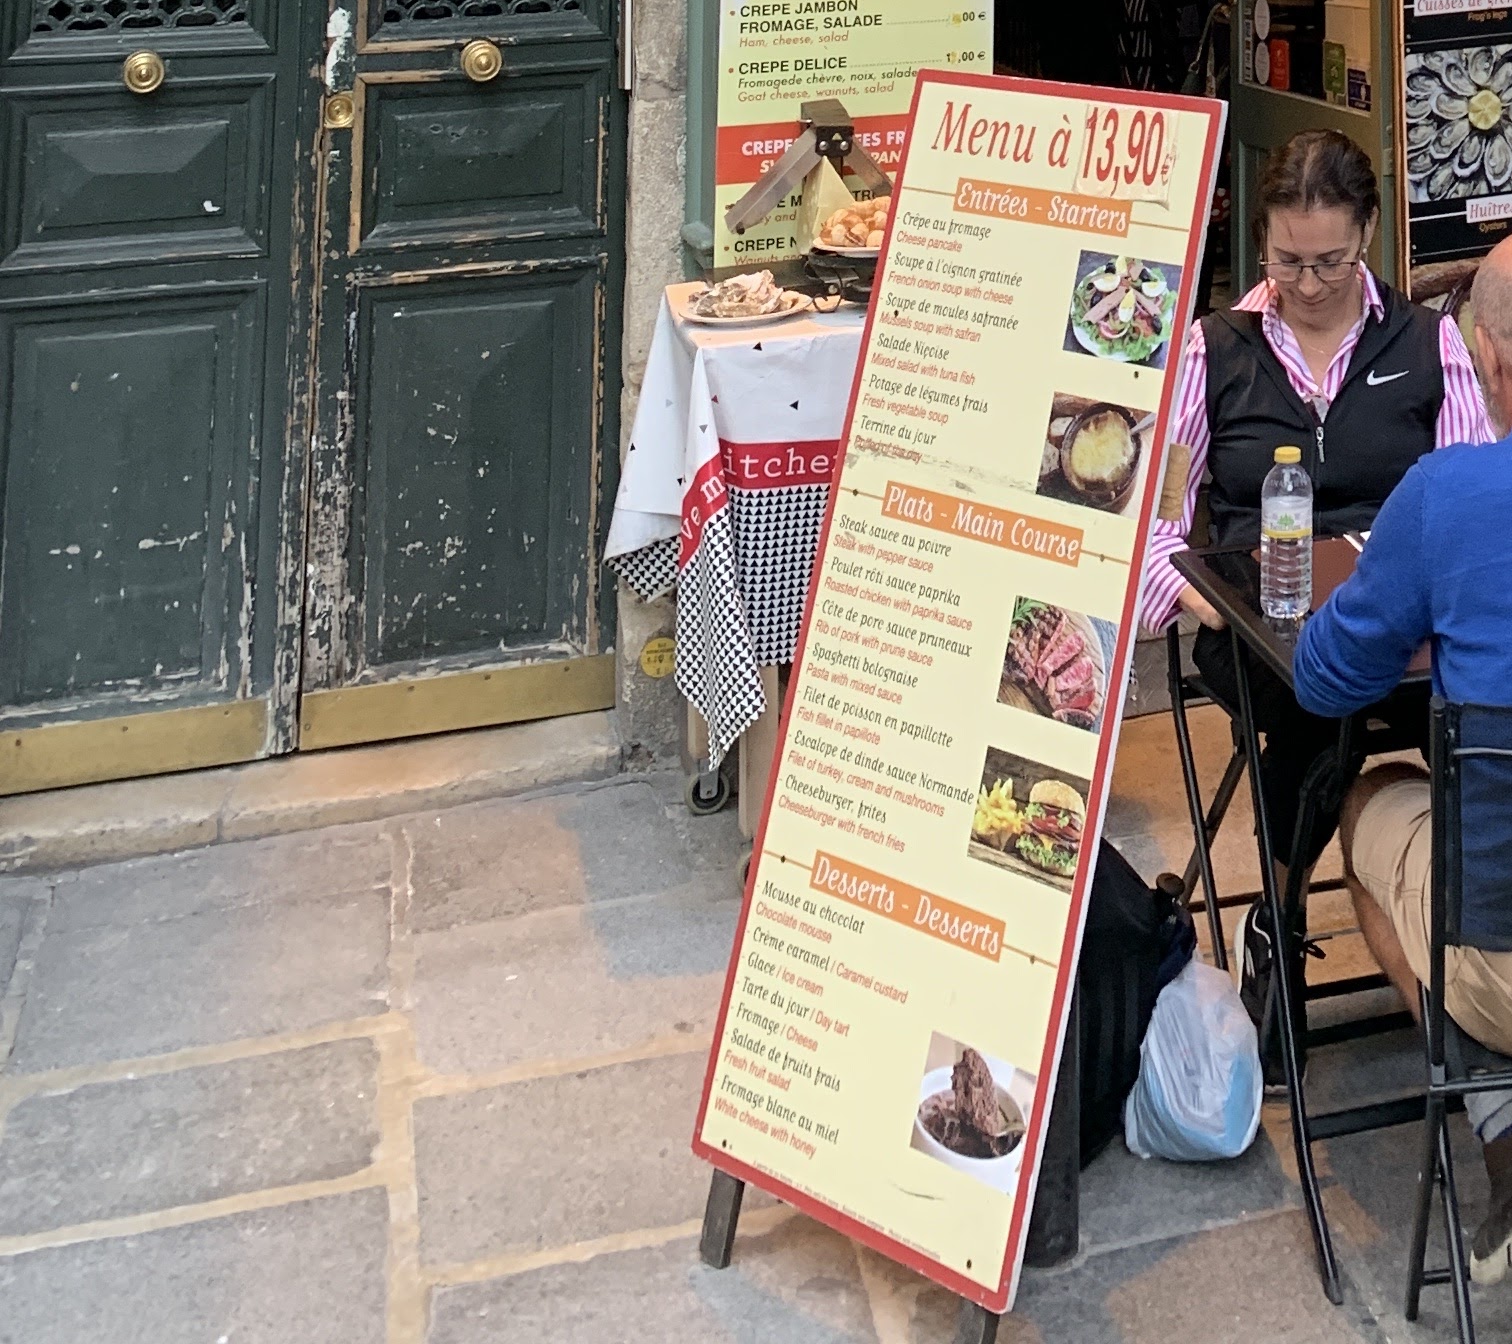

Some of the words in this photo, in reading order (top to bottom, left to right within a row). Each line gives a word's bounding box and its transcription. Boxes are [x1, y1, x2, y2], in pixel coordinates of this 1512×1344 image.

[739, 2, 792, 19] CREPE
[739, 17, 819, 35] FROMAGE,
[822, 13, 884, 30] SALADE
[737, 59, 790, 76] CREPE
[793, 55, 848, 72] DELICE
[930, 100, 1037, 164] Menu
[1047, 113, 1073, 169] à
[902, 210, 932, 231] Crêpe
[931, 218, 947, 232] au
[946, 218, 992, 242] fromage
[956, 181, 1029, 218] Entrées
[1046, 194, 1127, 233] Starters
[734, 238, 780, 253] CREPE
[893, 250, 926, 272] Soupe
[977, 269, 1024, 288] gratinée
[885, 291, 917, 313] Soupe
[917, 298, 932, 314] de
[932, 303, 970, 322] moules
[970, 310, 1020, 331] safranée
[876, 332, 912, 353] Salade
[912, 339, 951, 361] Niçoise
[867, 373, 903, 397] Potage
[903, 381, 918, 398] de
[918, 384, 961, 408] légumes
[961, 394, 989, 414] frais
[860, 413, 897, 437] Terrine
[896, 424, 913, 441] du
[911, 430, 938, 446] jour
[838, 513, 869, 535] Steak
[867, 524, 900, 544] sauce
[900, 533, 916, 549] au
[916, 538, 953, 558] poivre
[884, 485, 934, 524] Plats
[950, 502, 1005, 542] Main
[1010, 517, 1080, 561] Course
[830, 555, 864, 579] Poulet
[864, 567, 884, 585] rôti
[884, 574, 918, 595] sauce
[916, 584, 962, 608] paprika
[821, 598, 845, 619] Côte
[844, 606, 860, 624] de
[858, 613, 885, 631] porc
[885, 621, 918, 641] sauce
[917, 630, 974, 658] pruneaux
[811, 641, 861, 671] Spaghetti
[861, 656, 919, 689] bolognaise
[802, 684, 827, 707] Filet
[826, 693, 842, 712] de
[840, 701, 883, 726] poisson
[883, 715, 899, 731] en
[793, 728, 839, 759] Escalope
[838, 745, 854, 763] de
[853, 750, 885, 774] dinde
[885, 764, 918, 786] sauce
[918, 771, 975, 806] Normande
[856, 799, 887, 825] frites
[761, 879, 802, 909] Mousse
[801, 899, 818, 916] au
[818, 904, 866, 935] chocolat
[812, 855, 896, 914] Desserts
[912, 894, 1000, 956] Desserts
[747, 950, 777, 977] Glace
[752, 925, 786, 953] Crème
[785, 943, 831, 972] caramel
[735, 1001, 781, 1037] Fromage
[741, 975, 770, 1001] Tarte
[769, 989, 786, 1009] du
[784, 999, 811, 1019] jour
[730, 1027, 767, 1057] Salade
[767, 1045, 782, 1064] de
[781, 1051, 813, 1079] fruits
[813, 1065, 841, 1093] frais
[720, 1073, 765, 1110] Fromage
[765, 1094, 797, 1124] blanc
[797, 1114, 814, 1133] au
[814, 1122, 840, 1145] miel
